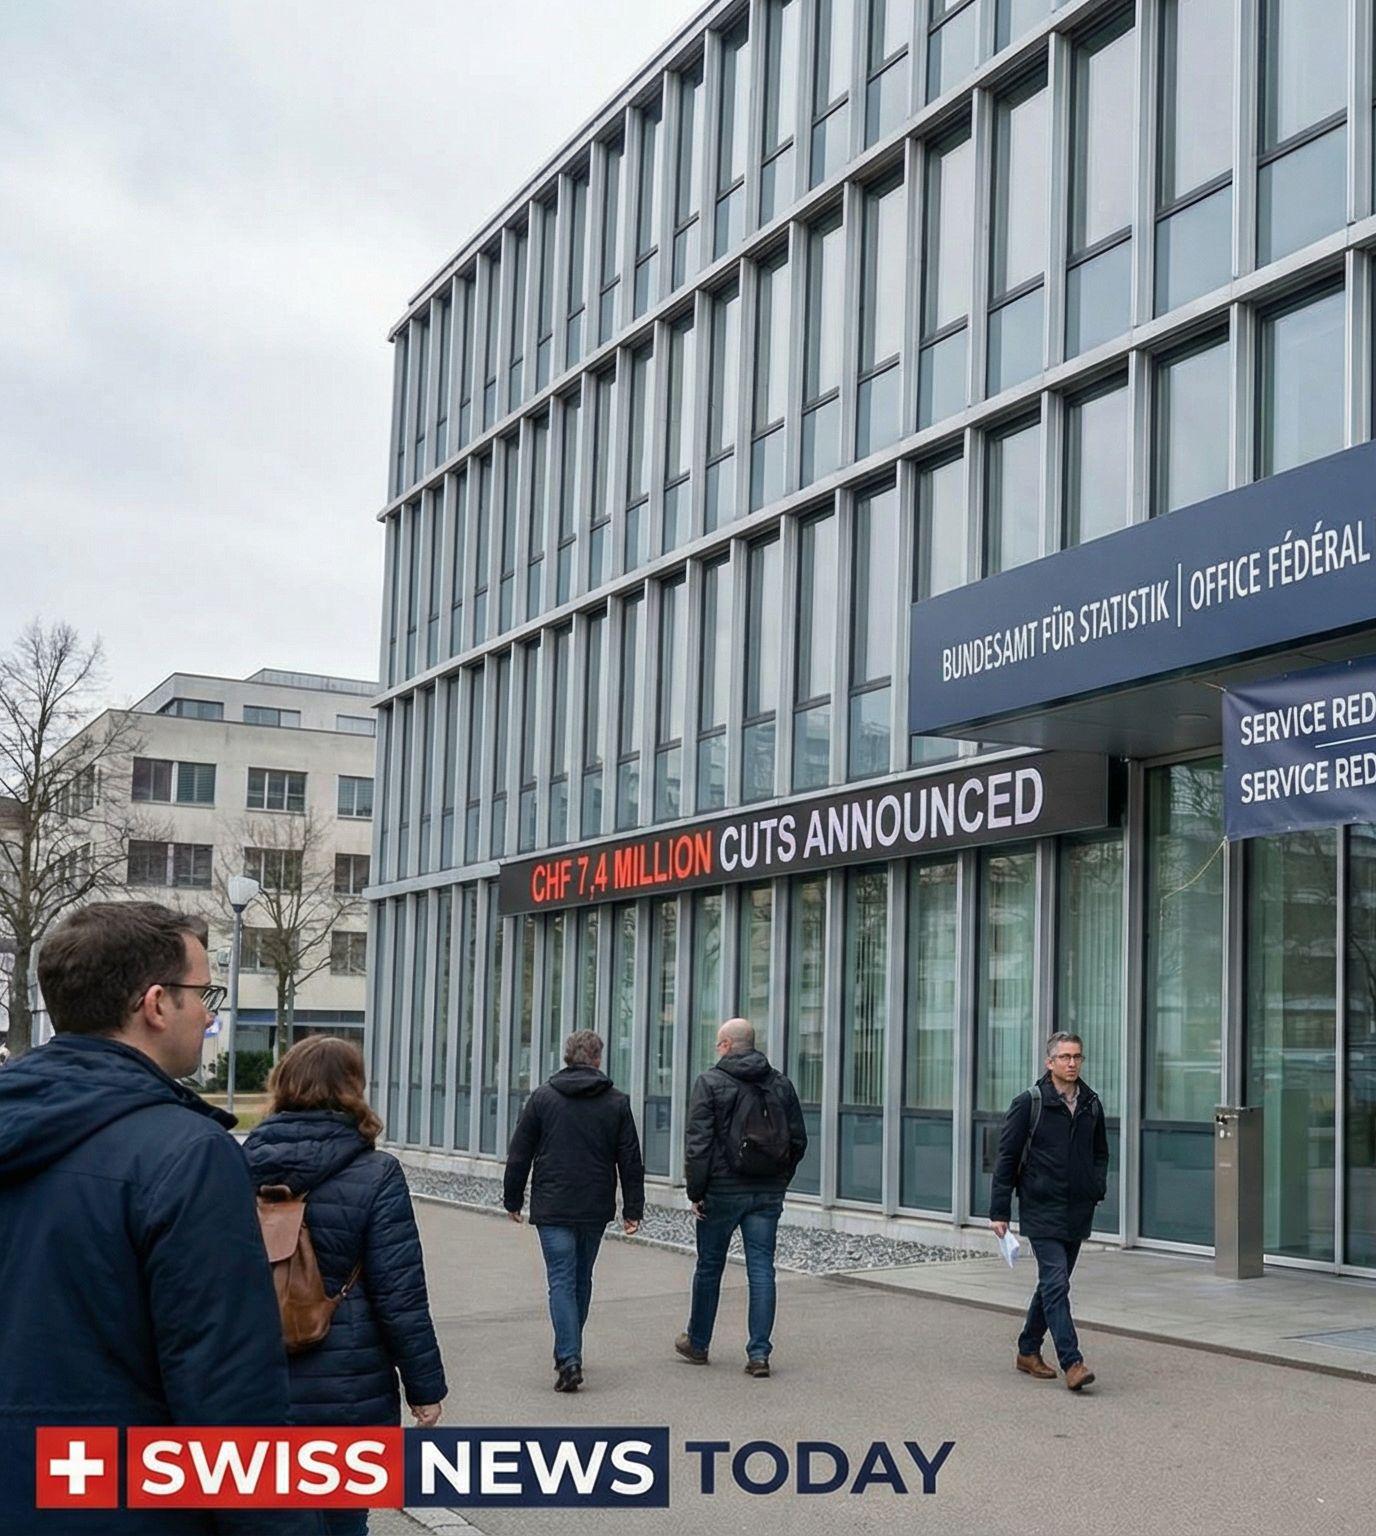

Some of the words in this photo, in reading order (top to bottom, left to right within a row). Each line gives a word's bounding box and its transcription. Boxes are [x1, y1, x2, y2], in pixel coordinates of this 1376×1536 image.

[942, 621, 1037, 682] BUNDESAMT
[1042, 604, 1075, 654] FÜR
[1079, 580, 1170, 643] STATISTIK
[1190, 552, 1261, 611] OFFICE
[1268, 520, 1371, 589] FÉDÉRAL
[1240, 701, 1328, 747] SERVICE
[1240, 760, 1329, 804] SERVICE
[531, 859, 572, 903] CHF
[577, 854, 609, 901] 7,4
[613, 831, 712, 889] MILLION
[719, 814, 797, 872] CUTS
[802, 767, 1043, 859] ANNOUNCED
